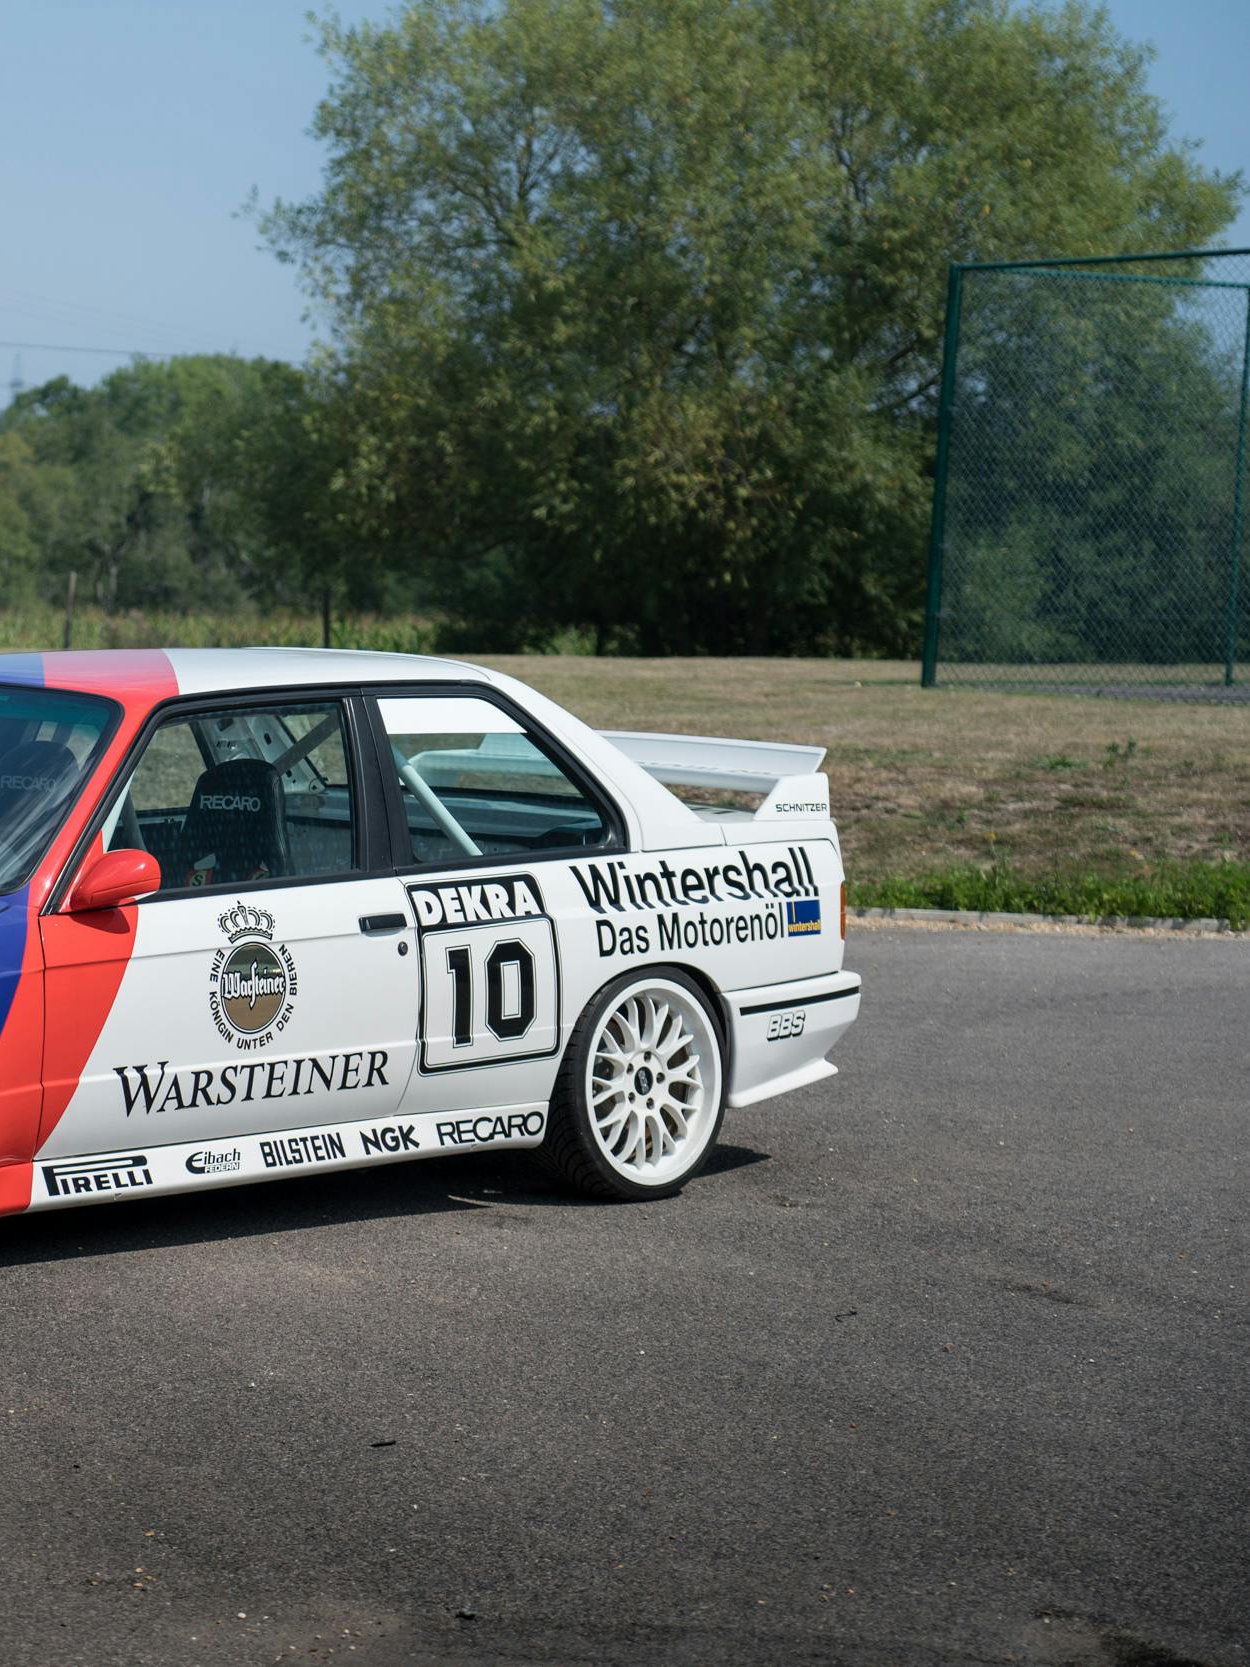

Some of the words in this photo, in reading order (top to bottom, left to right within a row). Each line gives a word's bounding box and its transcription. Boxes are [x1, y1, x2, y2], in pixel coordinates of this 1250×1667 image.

[200, 795, 261, 812] RECARO
[776, 803, 828, 812] SCHNITZER
[569, 846, 820, 914] Wintershall
[411, 881, 542, 927] DEKRA
[596, 919, 650, 957] Das
[657, 902, 785, 951] Motorenöl
[209, 948, 225, 983] EINE
[279, 944, 297, 996] BIEREN
[445, 937, 537, 1048] 10
[209, 991, 234, 1043] KÖNIGIN
[276, 1003, 294, 1031] DEN
[766, 1010, 806, 1041] BBS
[237, 1031, 274, 1050] UNTER
[113, 1050, 389, 1118] WARSTEINER
[360, 1124, 420, 1155] NGK
[436, 1111, 544, 1146] RECARO
[185, 1148, 241, 1174] Eibach
[205, 1162, 239, 1173] FEDERN
[259, 1132, 346, 1168] BILSTEIN
[41, 1155, 153, 1197] PIRELLI
